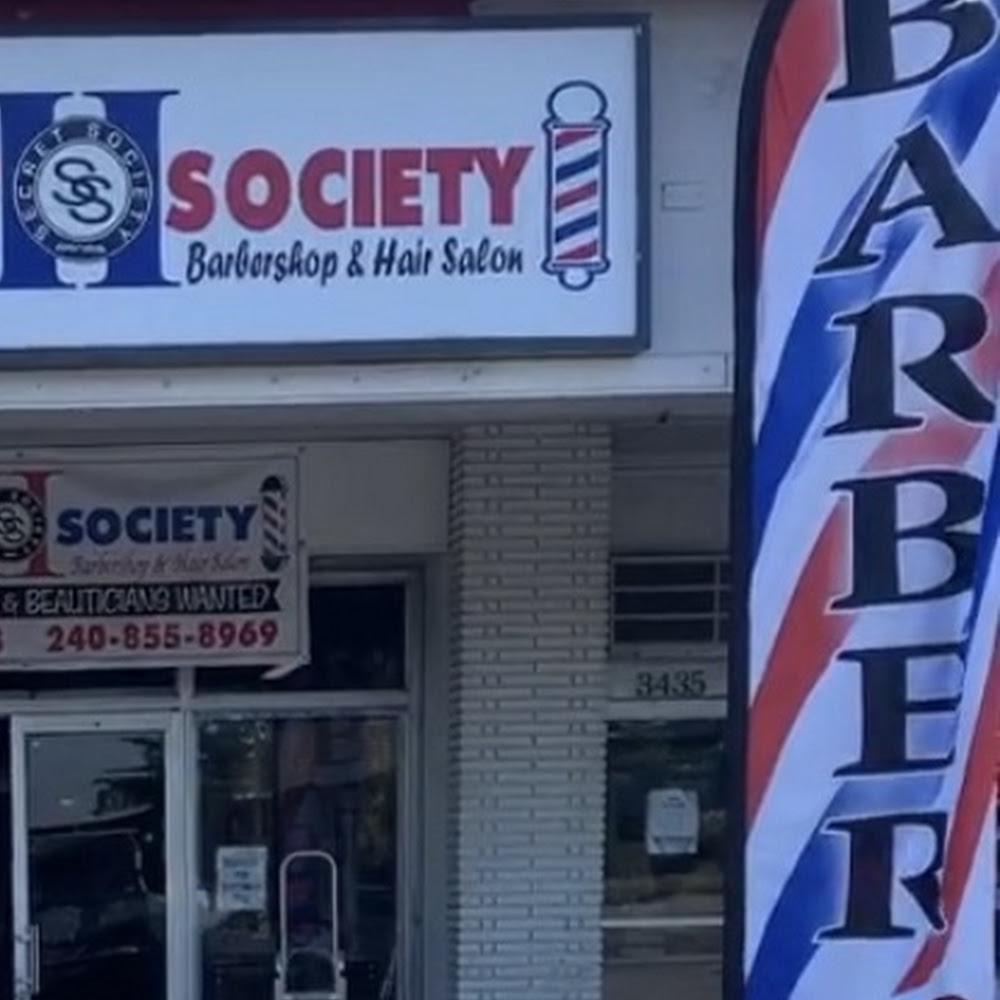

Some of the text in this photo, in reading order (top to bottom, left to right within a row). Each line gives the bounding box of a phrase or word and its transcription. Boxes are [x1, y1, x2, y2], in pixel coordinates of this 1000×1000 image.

[165, 146, 535, 233] SOCIETY
[186, 237, 524, 286] Barbershop & Hair Salon
[812, 0, 1000, 941] BARBER
[56, 504, 259, 547] SOCIETY
[25, 586, 170, 614] BEAUTICIANS
[176, 584, 270, 611] WANTED
[46, 620, 279, 652] 240-855-8969
[635, 670, 707, 697] 3435
